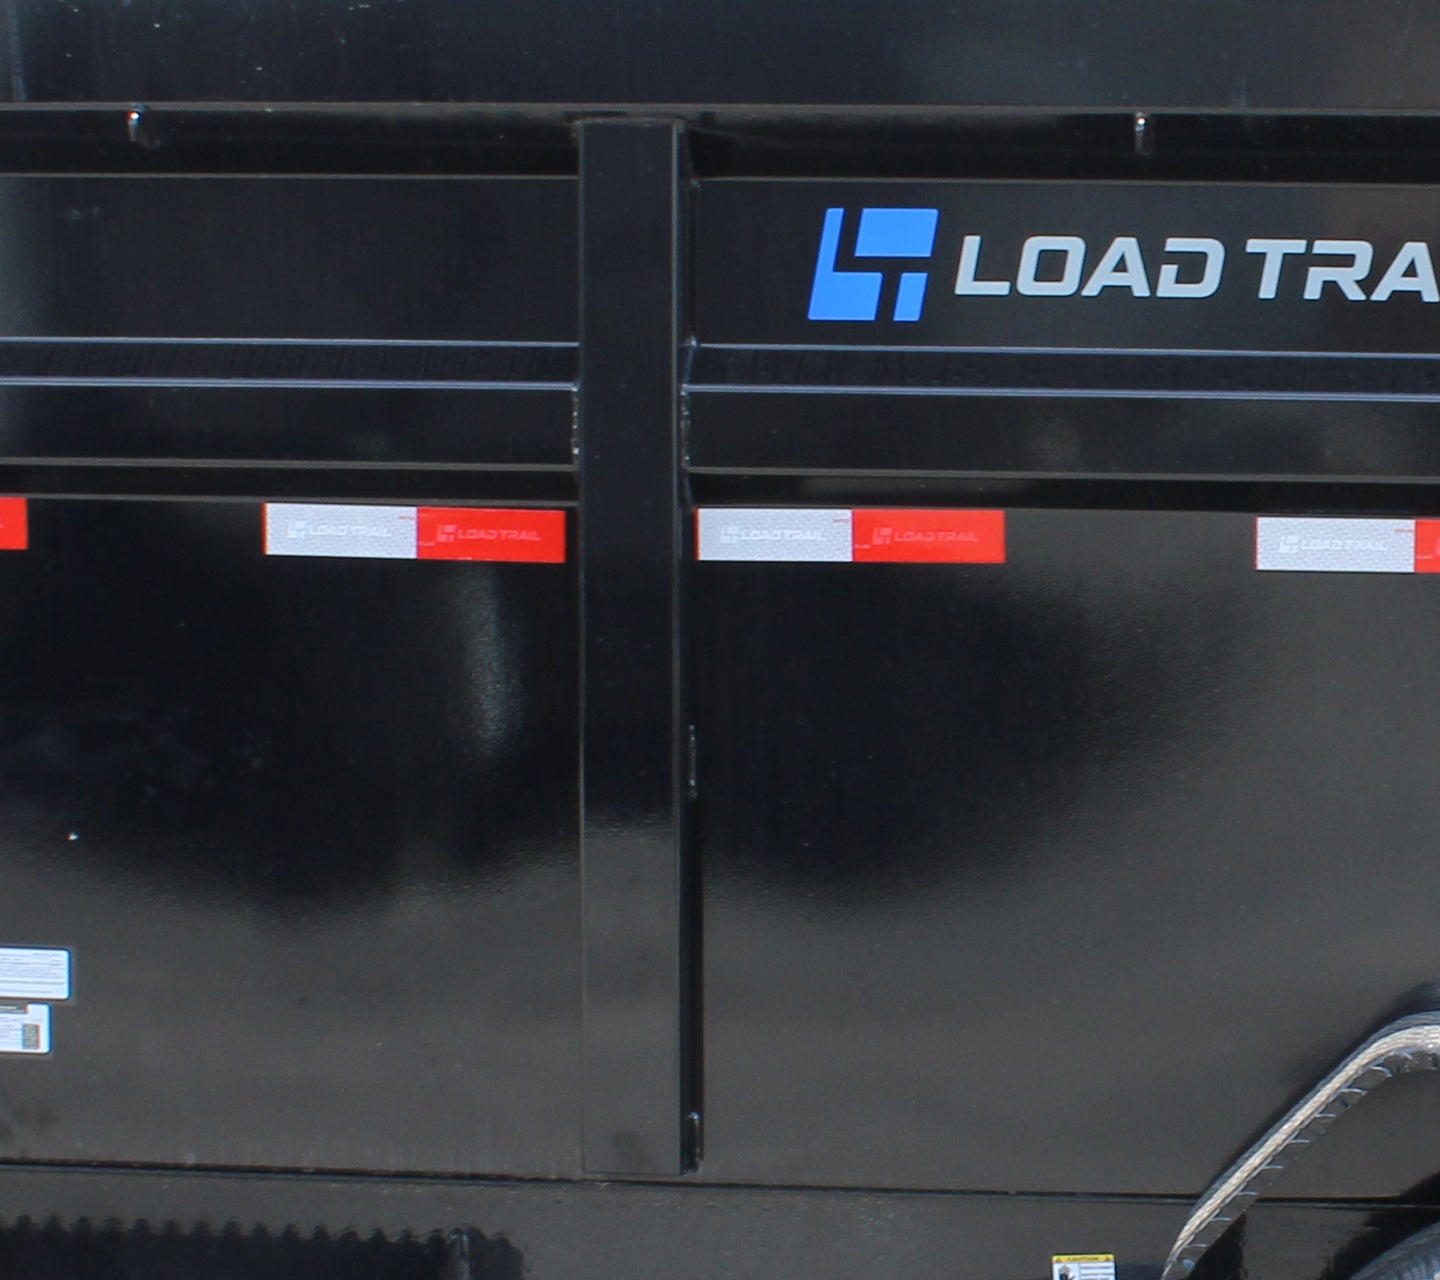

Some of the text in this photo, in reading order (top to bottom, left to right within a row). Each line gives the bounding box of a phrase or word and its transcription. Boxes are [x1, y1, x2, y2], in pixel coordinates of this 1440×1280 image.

[954, 235, 1226, 298] LOAD
[457, 528, 498, 540] LOAD
[893, 531, 934, 542] LOAD
